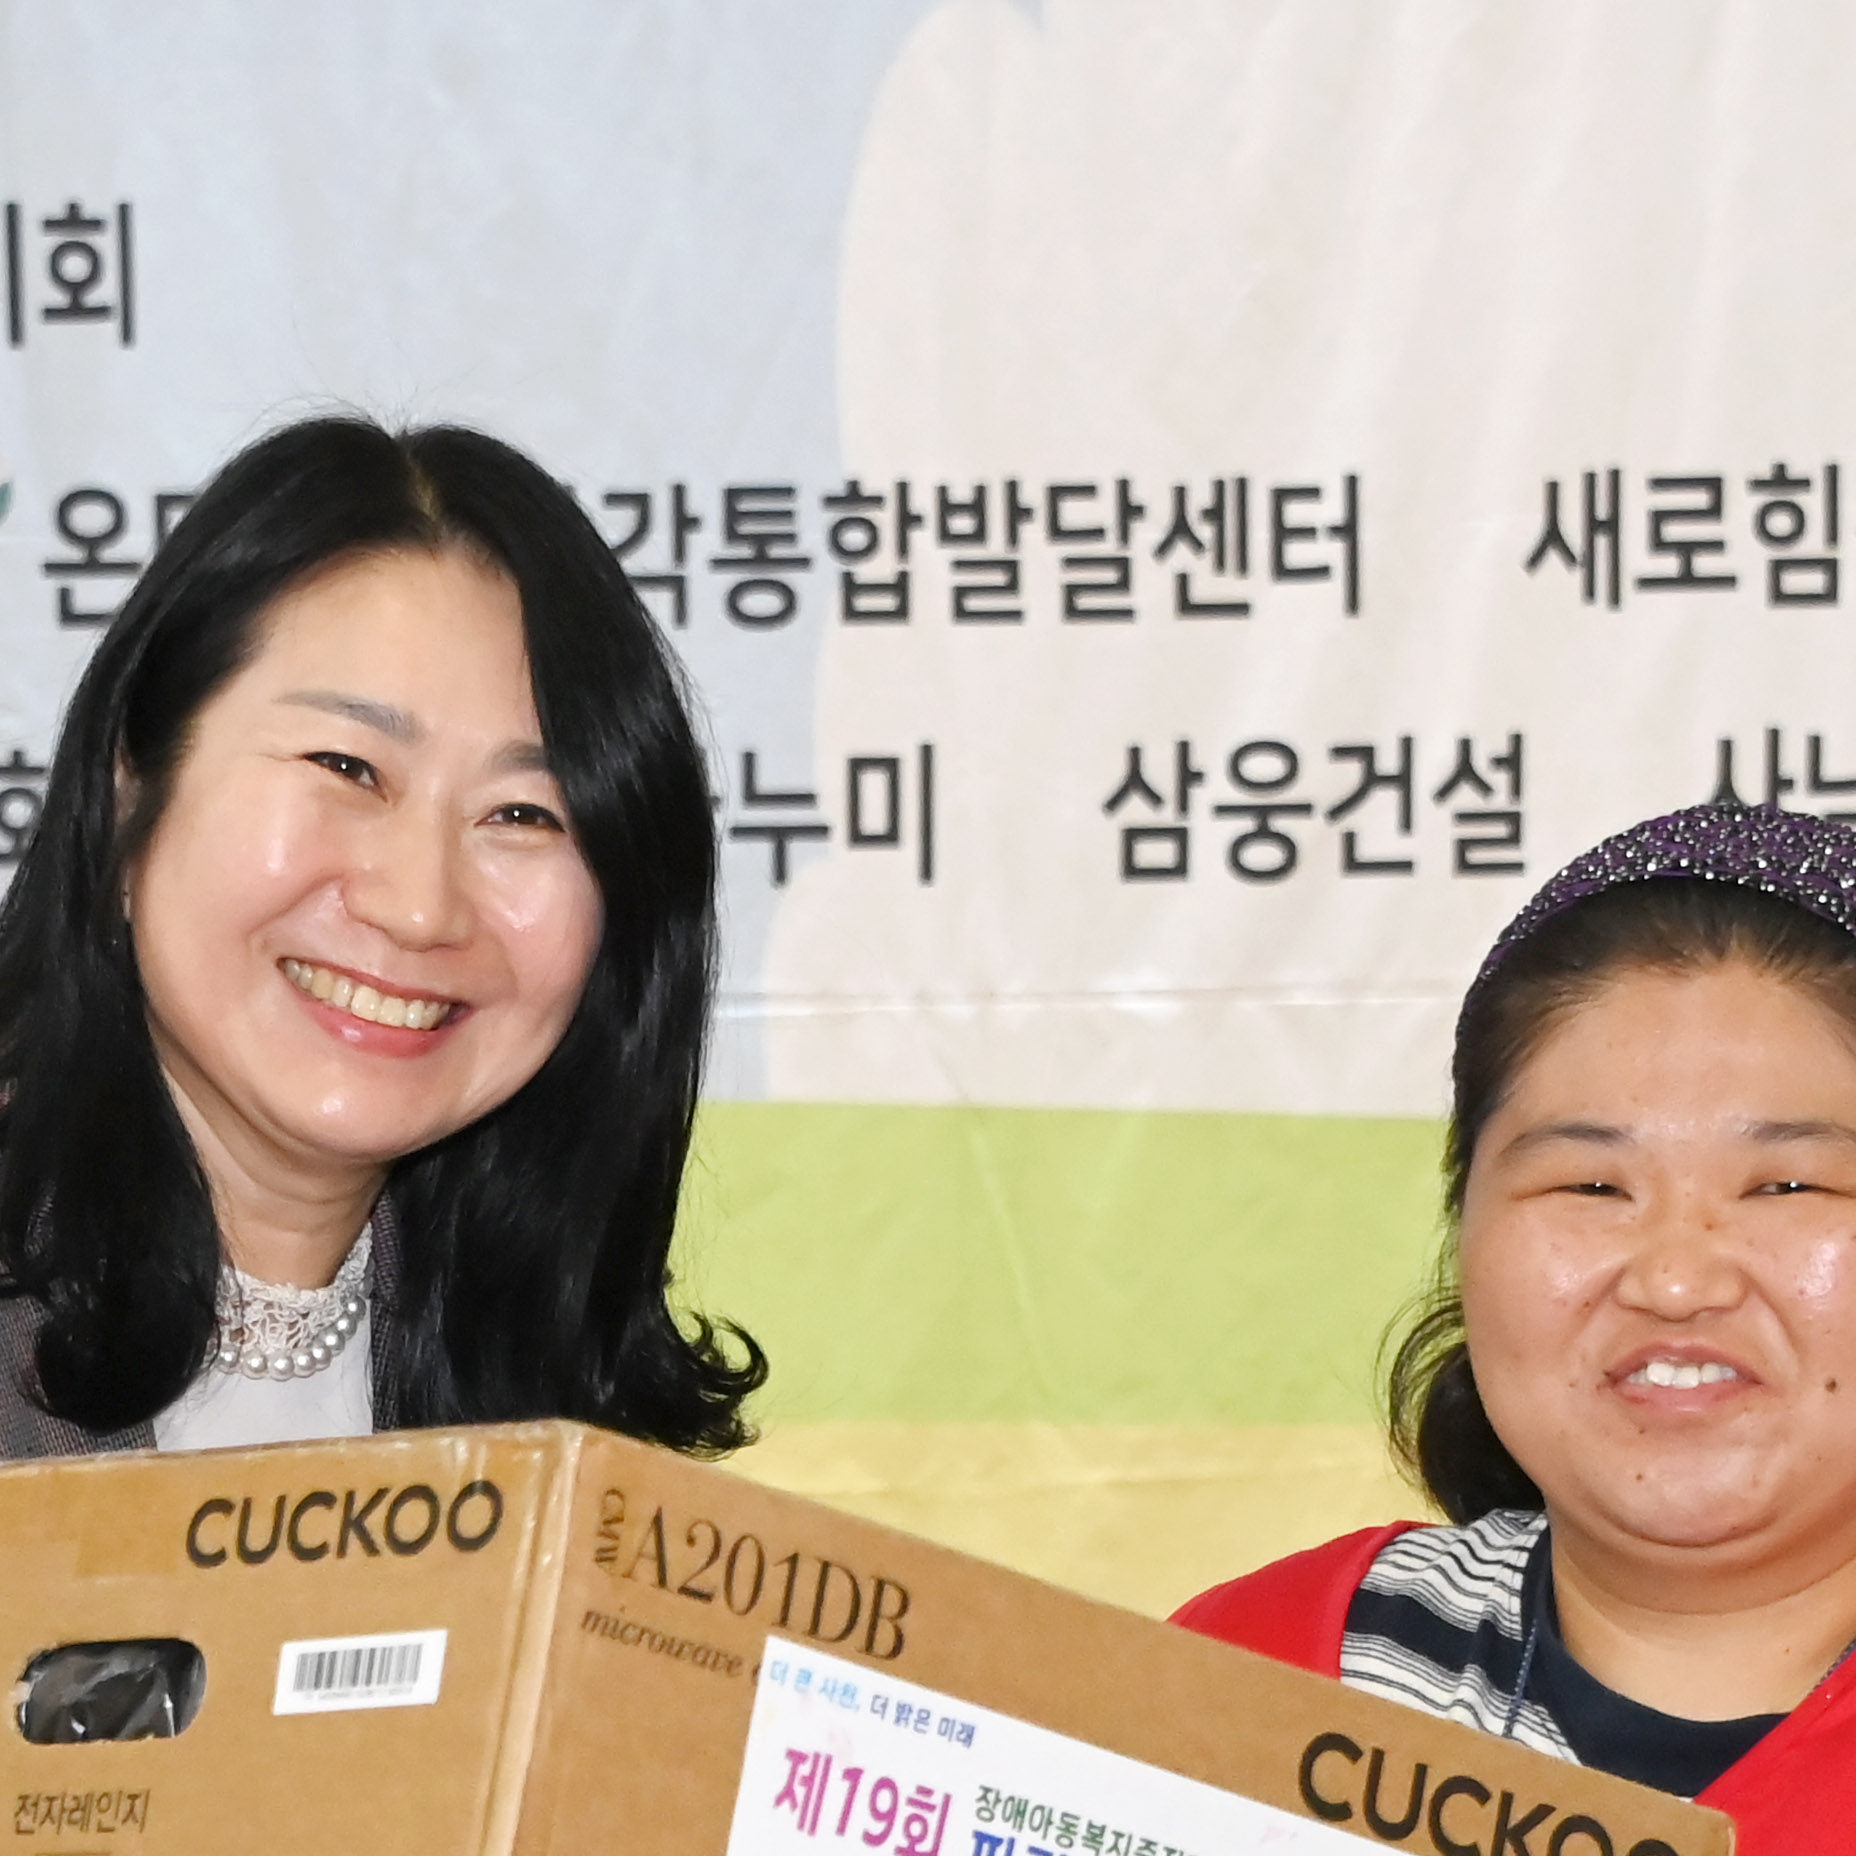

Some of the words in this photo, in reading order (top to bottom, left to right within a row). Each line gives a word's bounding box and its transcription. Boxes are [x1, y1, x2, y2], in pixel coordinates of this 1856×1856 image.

[1101, 730, 1529, 886] 삼웅건설
[185, 1476, 506, 1569] CUCKOO
[621, 1505, 912, 1662] A201DB
[580, 1604, 745, 1680] microwave
[869, 1693, 888, 1720] 더
[936, 1714, 977, 1749] 미래
[13, 1788, 152, 1836] 전자레인지
